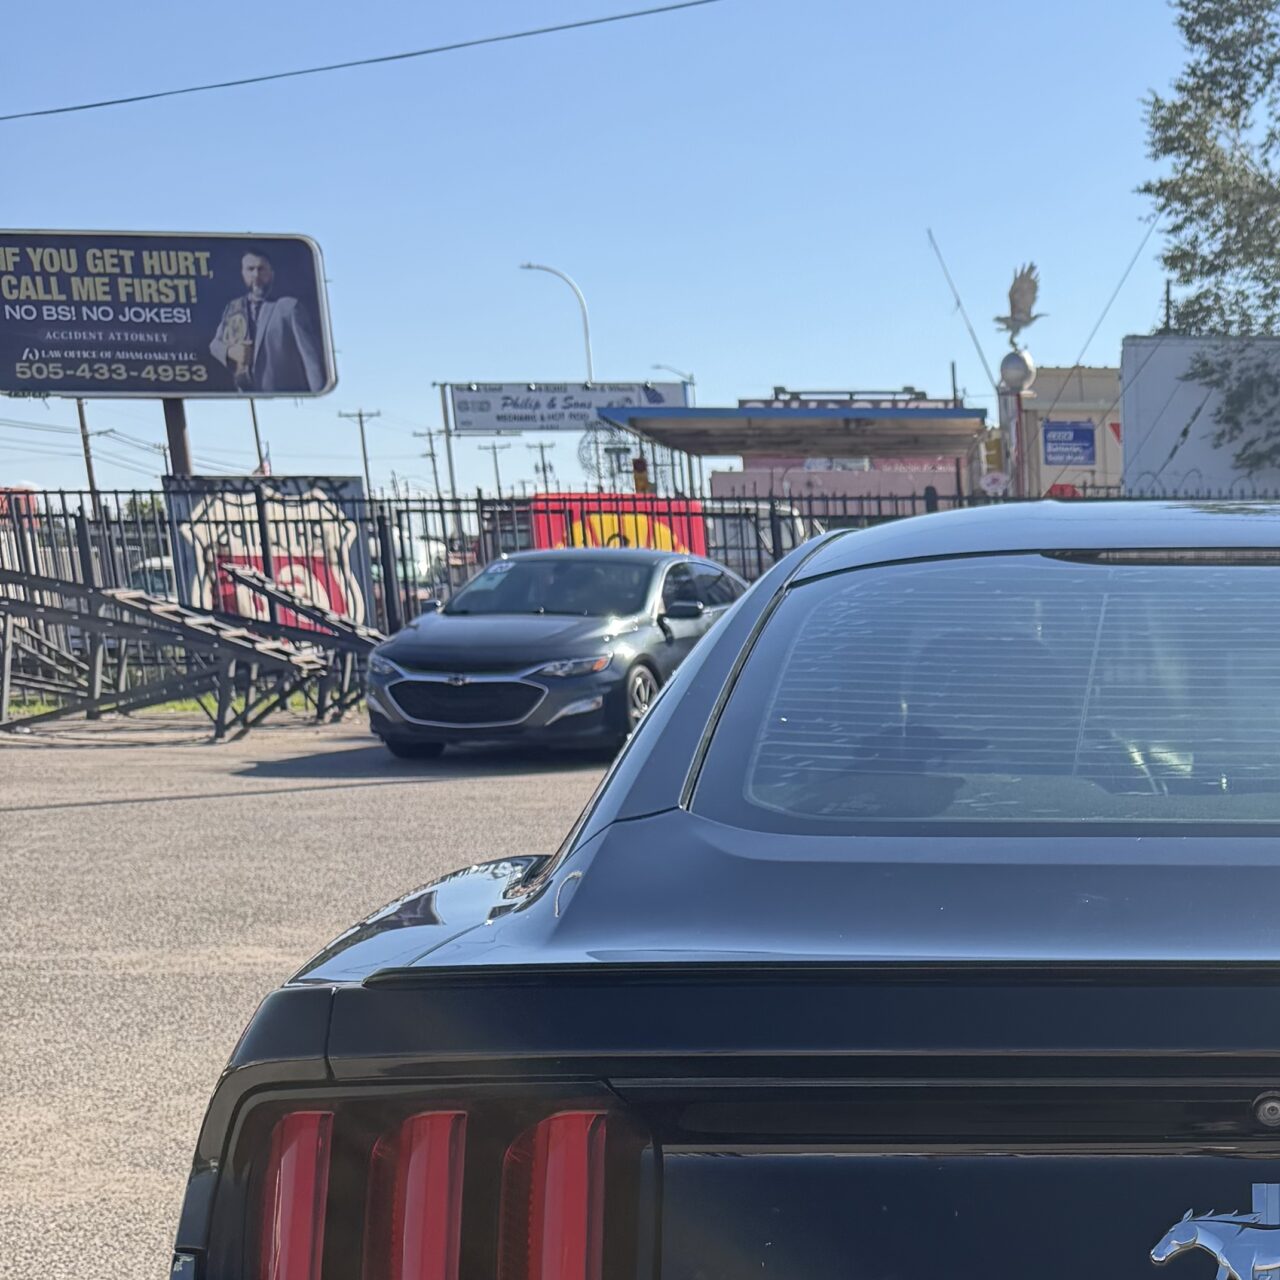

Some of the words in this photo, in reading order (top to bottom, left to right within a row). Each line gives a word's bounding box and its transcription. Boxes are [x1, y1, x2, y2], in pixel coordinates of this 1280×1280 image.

[0, 246, 20, 272] IF
[25, 247, 78, 273] YOU
[86, 248, 135, 275] GET
[142, 250, 213, 279] HURT,
[1, 274, 67, 301] CALL
[71, 276, 112, 302] ME
[117, 277, 198, 304] FIRST!
[5, 304, 37, 320] NO
[42, 305, 76, 321] BS!
[82, 306, 114, 322] NO
[118, 306, 192, 323] JOKES!
[45, 331, 103, 340] ACCIDENT
[108, 332, 168, 342] ATTORNEY
[41, 349, 62, 358] LAW
[63, 350, 97, 359] OFFICE
[15, 362, 208, 382] 505-433-4953
[546, 396, 556, 410] &
